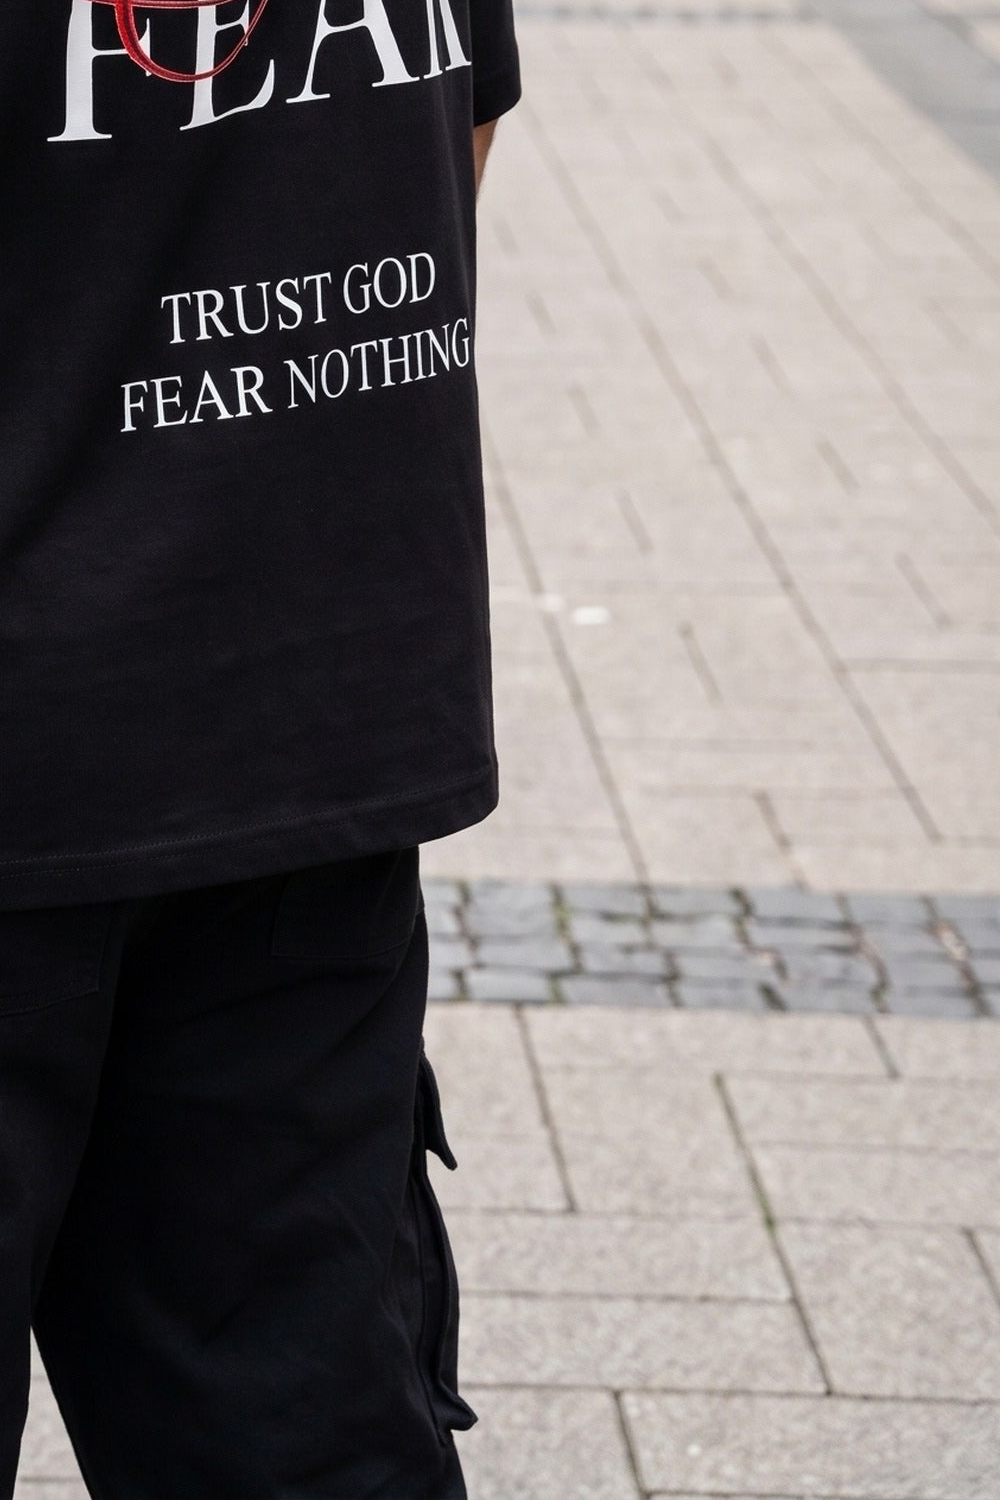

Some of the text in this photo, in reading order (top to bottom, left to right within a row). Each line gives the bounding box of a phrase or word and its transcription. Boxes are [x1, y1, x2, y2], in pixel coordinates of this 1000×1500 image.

[160, 251, 436, 344] TRUST GOD
[120, 317, 470, 433] FEAR NOTHING
